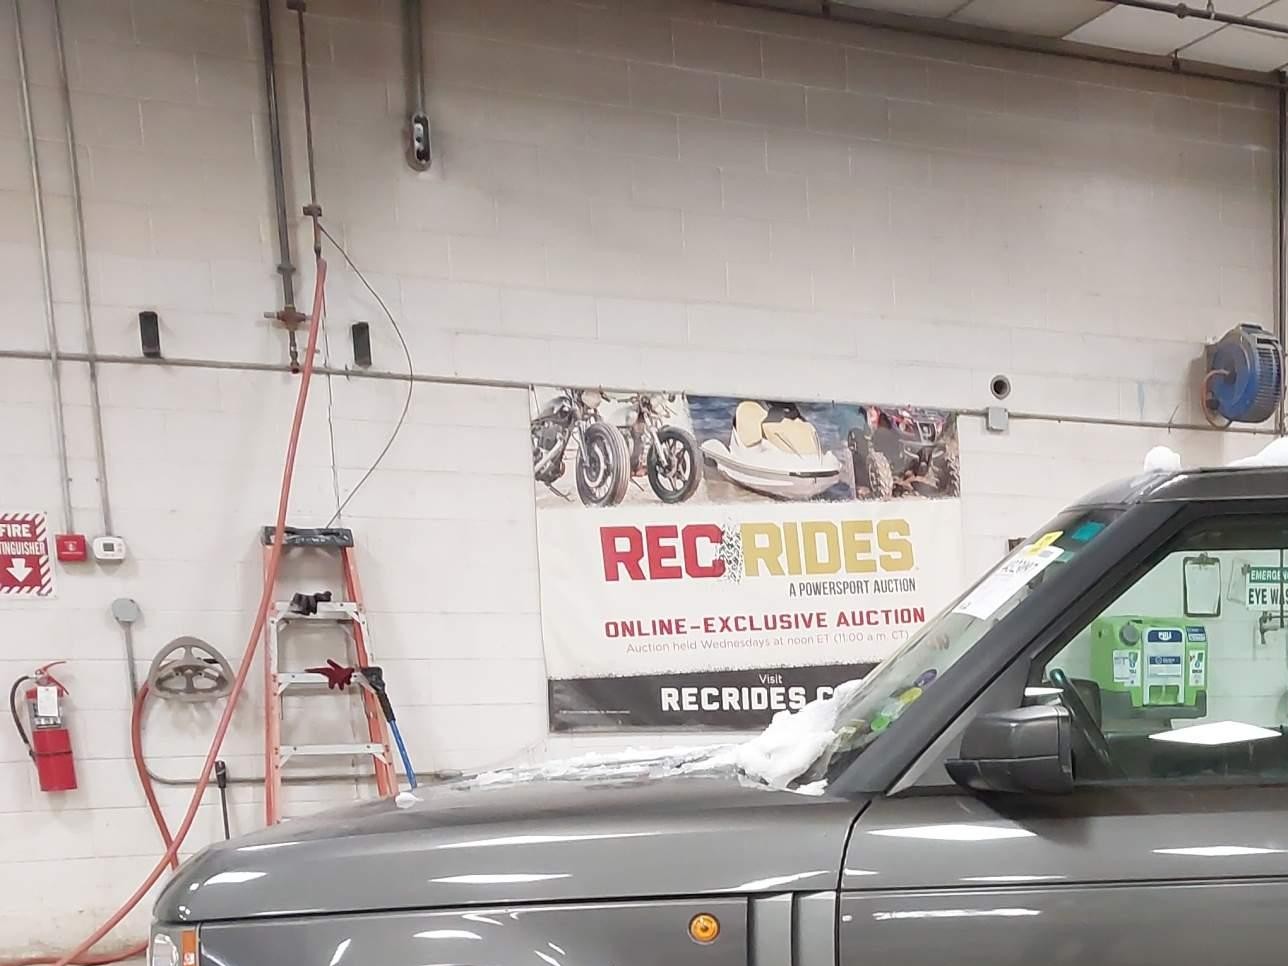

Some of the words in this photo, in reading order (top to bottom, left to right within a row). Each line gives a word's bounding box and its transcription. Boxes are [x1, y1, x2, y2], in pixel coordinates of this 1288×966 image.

[0, 523, 32, 538] FIRE
[599, 524, 726, 581] REC
[740, 519, 915, 577] RIDES
[789, 582, 797, 598] A
[799, 579, 870, 597] POWERSPORT
[873, 577, 917, 594] AUCTION
[1249, 588, 1268, 605] EYE
[605, 612, 829, 638] ONLINE-EXCLUSIVE
[836, 606, 926, 628] AUCTION
[626, 642, 670, 655] Auction
[673, 639, 697, 651] held
[701, 636, 770, 650] Wednesdays
[774, 636, 784, 647] at
[787, 635, 814, 646] noon
[817, 633, 829, 644] ET
[892, 629, 909, 641] CT)
[759, 673, 783, 684] Visit
